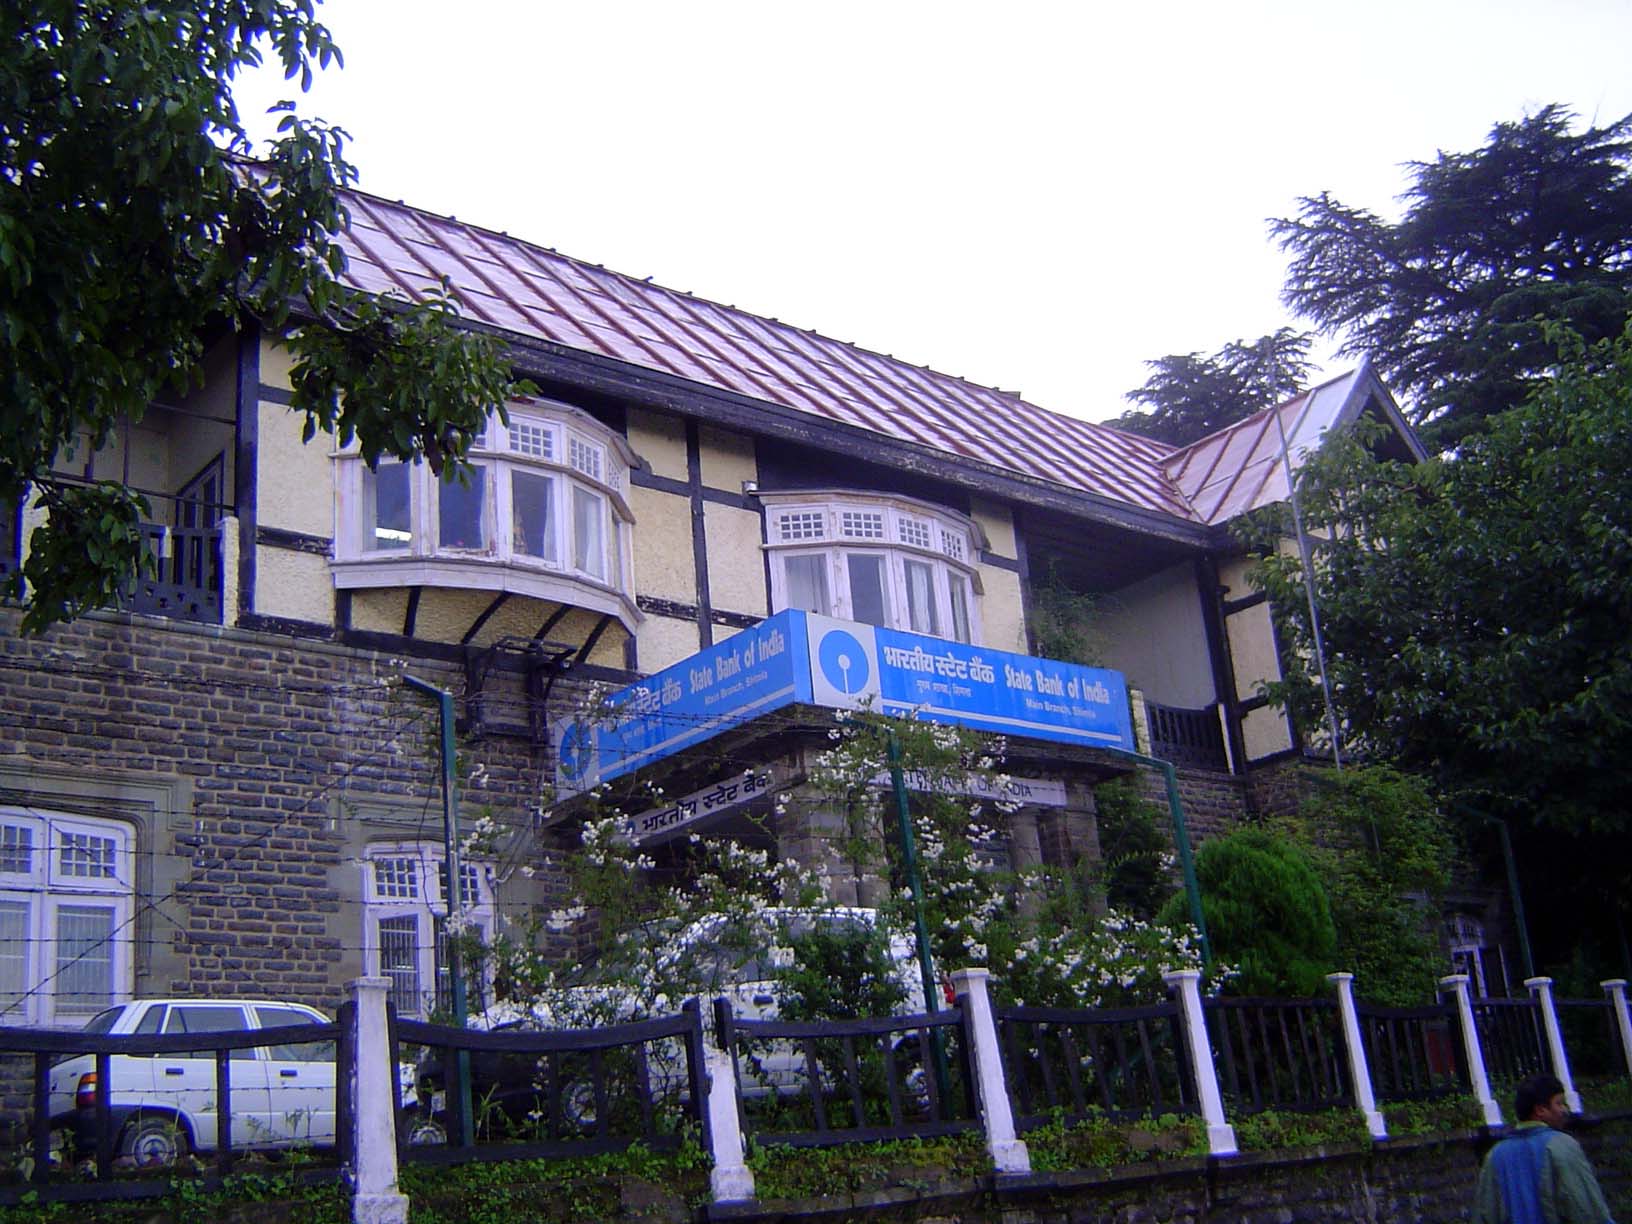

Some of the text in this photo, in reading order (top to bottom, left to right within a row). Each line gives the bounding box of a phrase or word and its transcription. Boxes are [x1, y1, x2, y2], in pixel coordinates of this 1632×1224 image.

[691, 628, 784, 694] State Bank of India
[884, 646, 994, 683] भारतीय स्टेट बैंक
[1004, 664, 1110, 704] State Bank of India
[1026, 698, 1043, 710] Main
